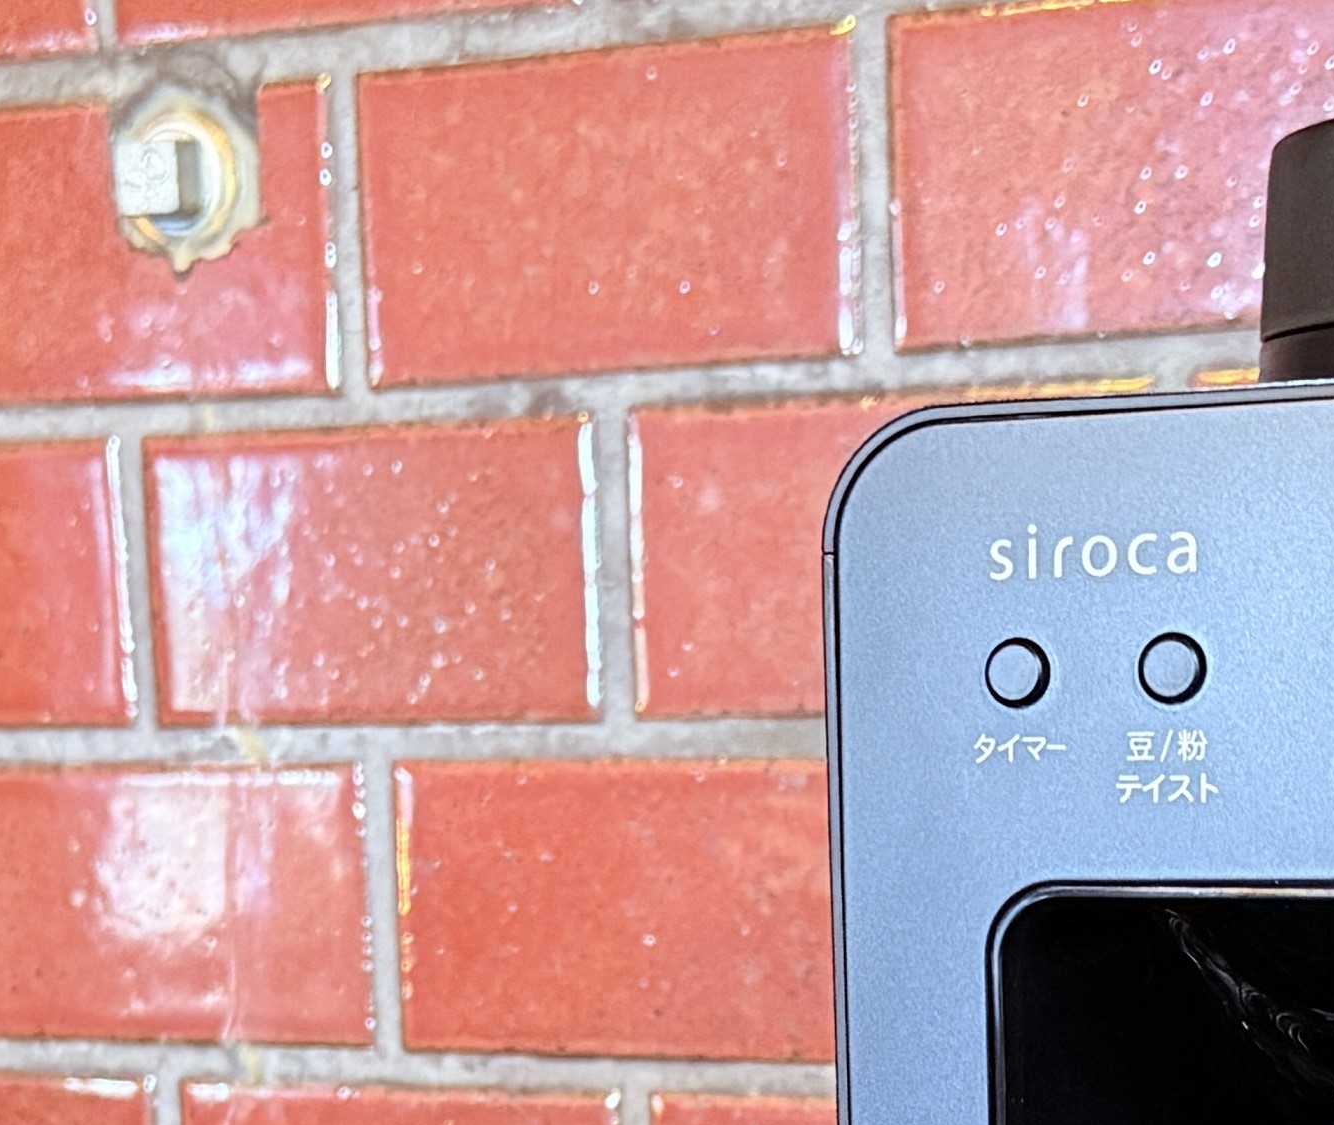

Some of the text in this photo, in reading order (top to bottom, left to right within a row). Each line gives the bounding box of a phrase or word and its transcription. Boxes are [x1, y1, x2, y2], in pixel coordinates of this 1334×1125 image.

[989, 523, 1198, 581] siroca
[973, 733, 1067, 764] タイマー
[1126, 728, 1208, 762] 豆/粉
[1116, 772, 1219, 803] テイスト
